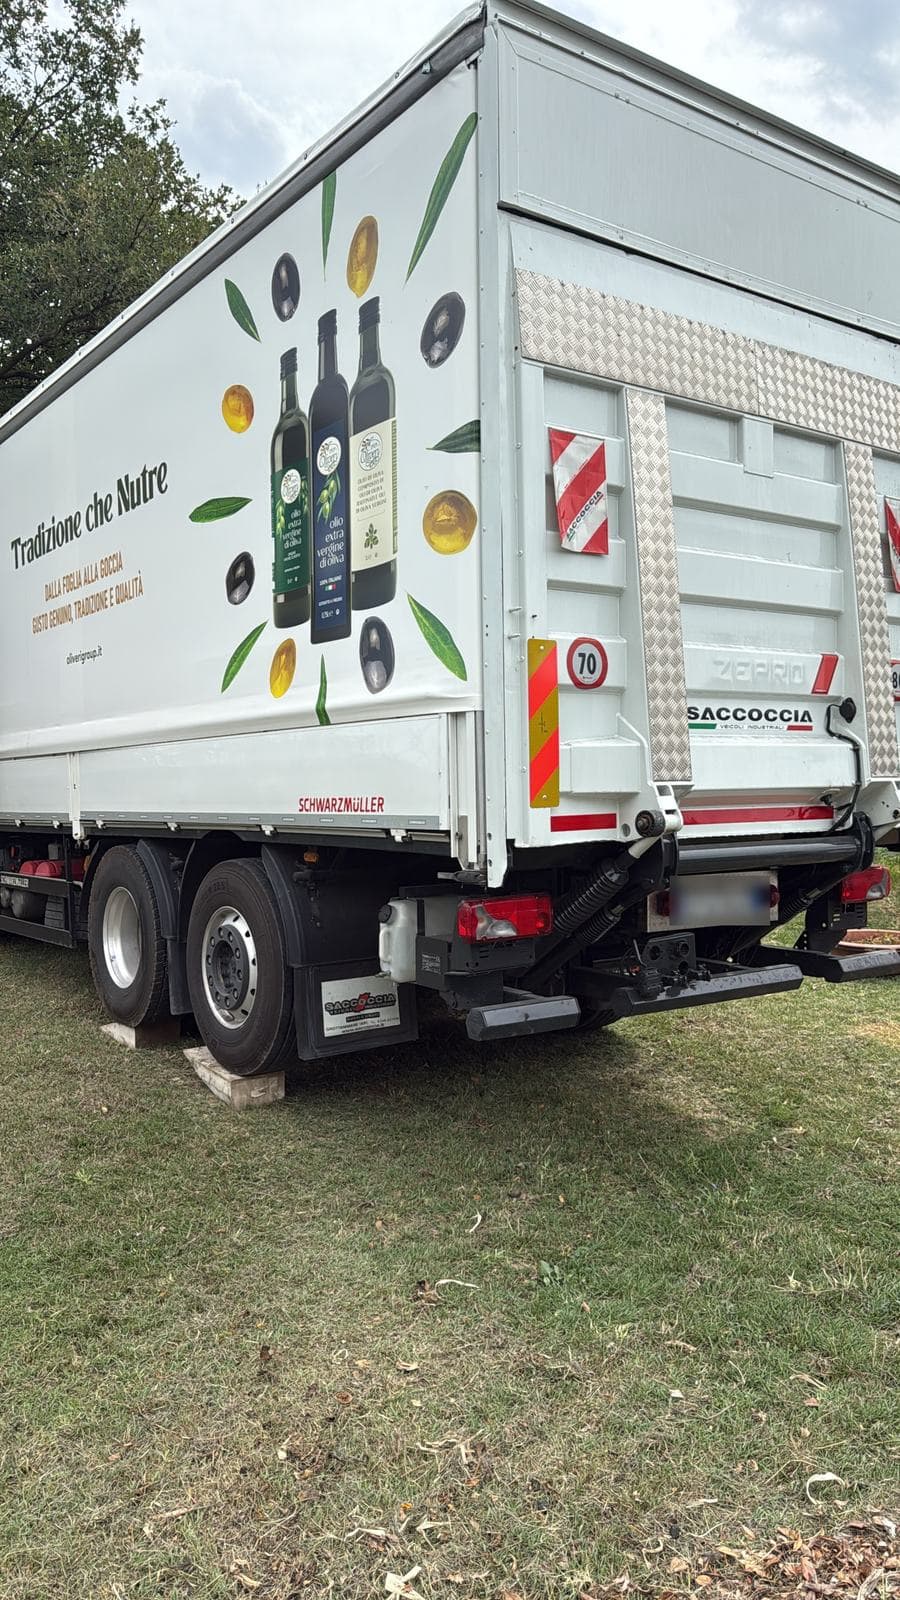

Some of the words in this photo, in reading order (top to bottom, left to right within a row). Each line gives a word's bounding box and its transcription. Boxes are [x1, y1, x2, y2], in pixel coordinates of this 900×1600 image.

[11, 515, 82, 570] Tradizione
[86, 491, 114, 532] che
[117, 462, 168, 516] Nutre
[290, 509, 301, 519] olio
[329, 516, 344, 529] olio
[287, 519, 302, 529] extra
[282, 528, 302, 543] vergine
[283, 540, 290, 550] di
[289, 537, 302, 549] oliva
[325, 529, 344, 543] extra
[317, 541, 345, 558] vergine
[319, 556, 327, 569] di
[327, 553, 345, 567] oliva
[45, 578, 62, 602] DALLA
[62, 569, 83, 595] FOGLIA
[83, 563, 99, 586] ALLA
[100, 551, 123, 579] GOCCIA
[32, 613, 49, 635] GUSTO
[74, 590, 108, 621] TRADIZIONE
[109, 587, 114, 607] E
[115, 570, 144, 605] QUALITÀ
[66, 645, 103, 665] oliverigroup.it
[578, 652, 597, 675] 70
[713, 658, 806, 686] ZEPRO
[687, 706, 813, 723] SACCOCCIA
[298, 796, 385, 813] SCHWARZMÜLLER
[325, 994, 396, 1011] SACCOCCIA
